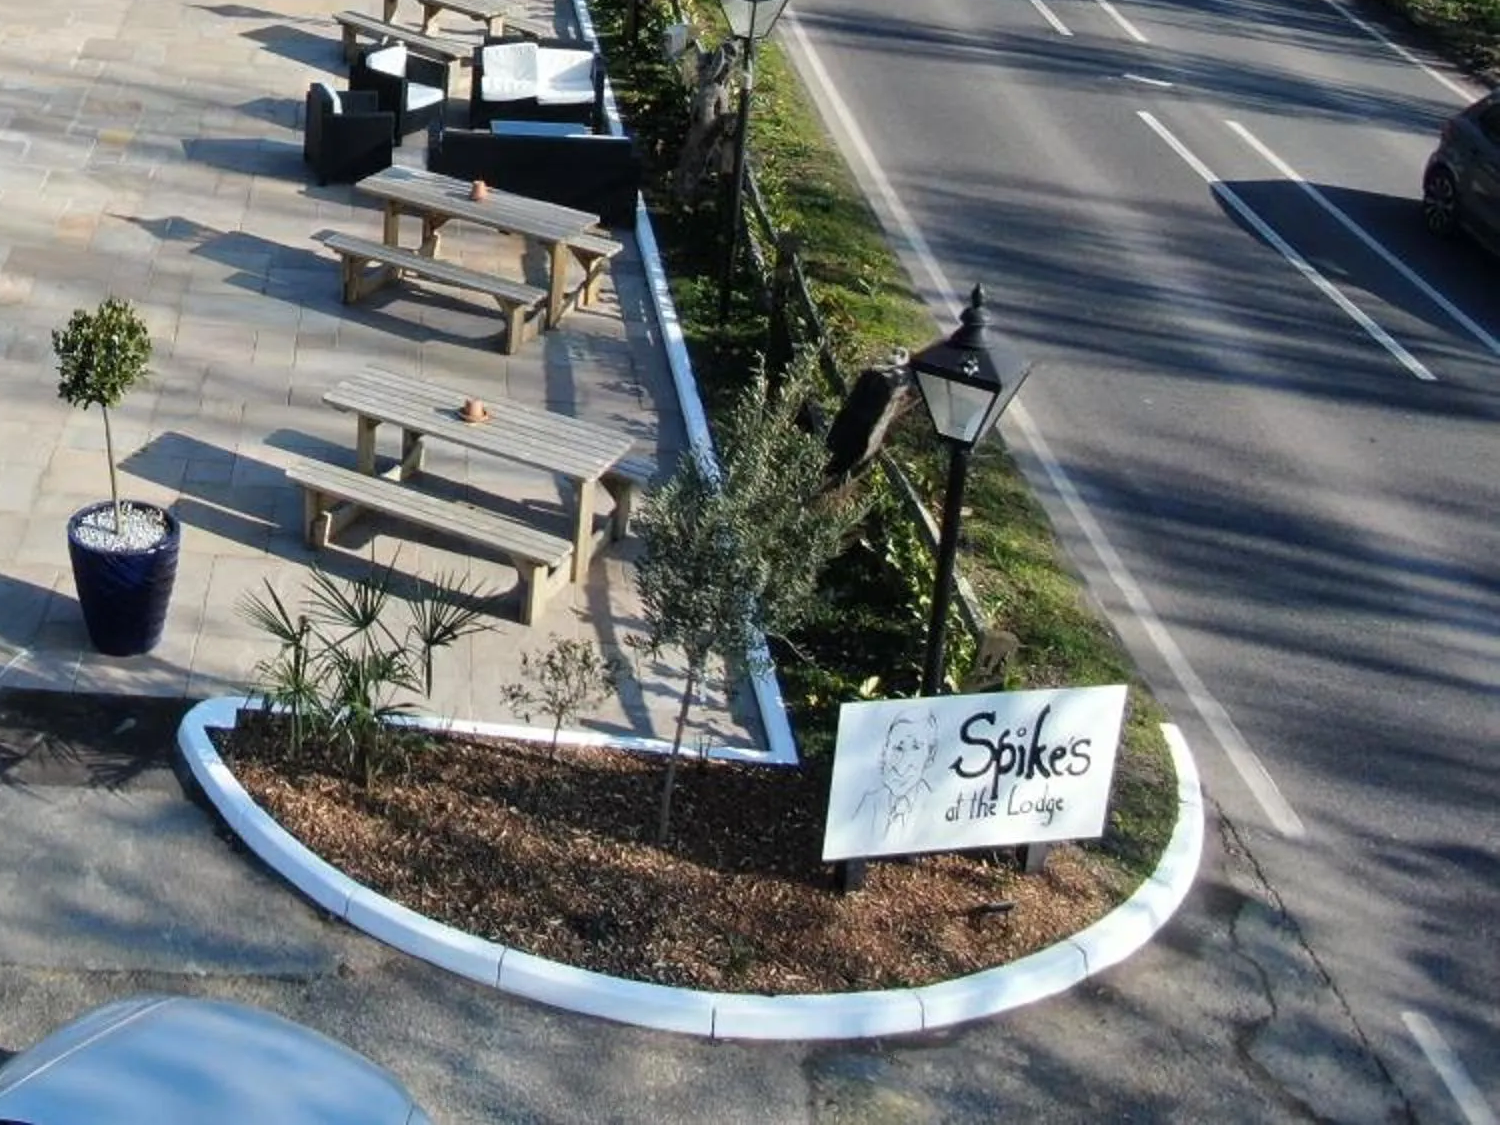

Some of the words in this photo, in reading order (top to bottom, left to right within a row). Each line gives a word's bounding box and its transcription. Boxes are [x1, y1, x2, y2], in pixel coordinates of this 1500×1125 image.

[945, 791, 962, 822] at
[969, 787, 996, 819] the
[1007, 783, 1063, 826] Lodge
